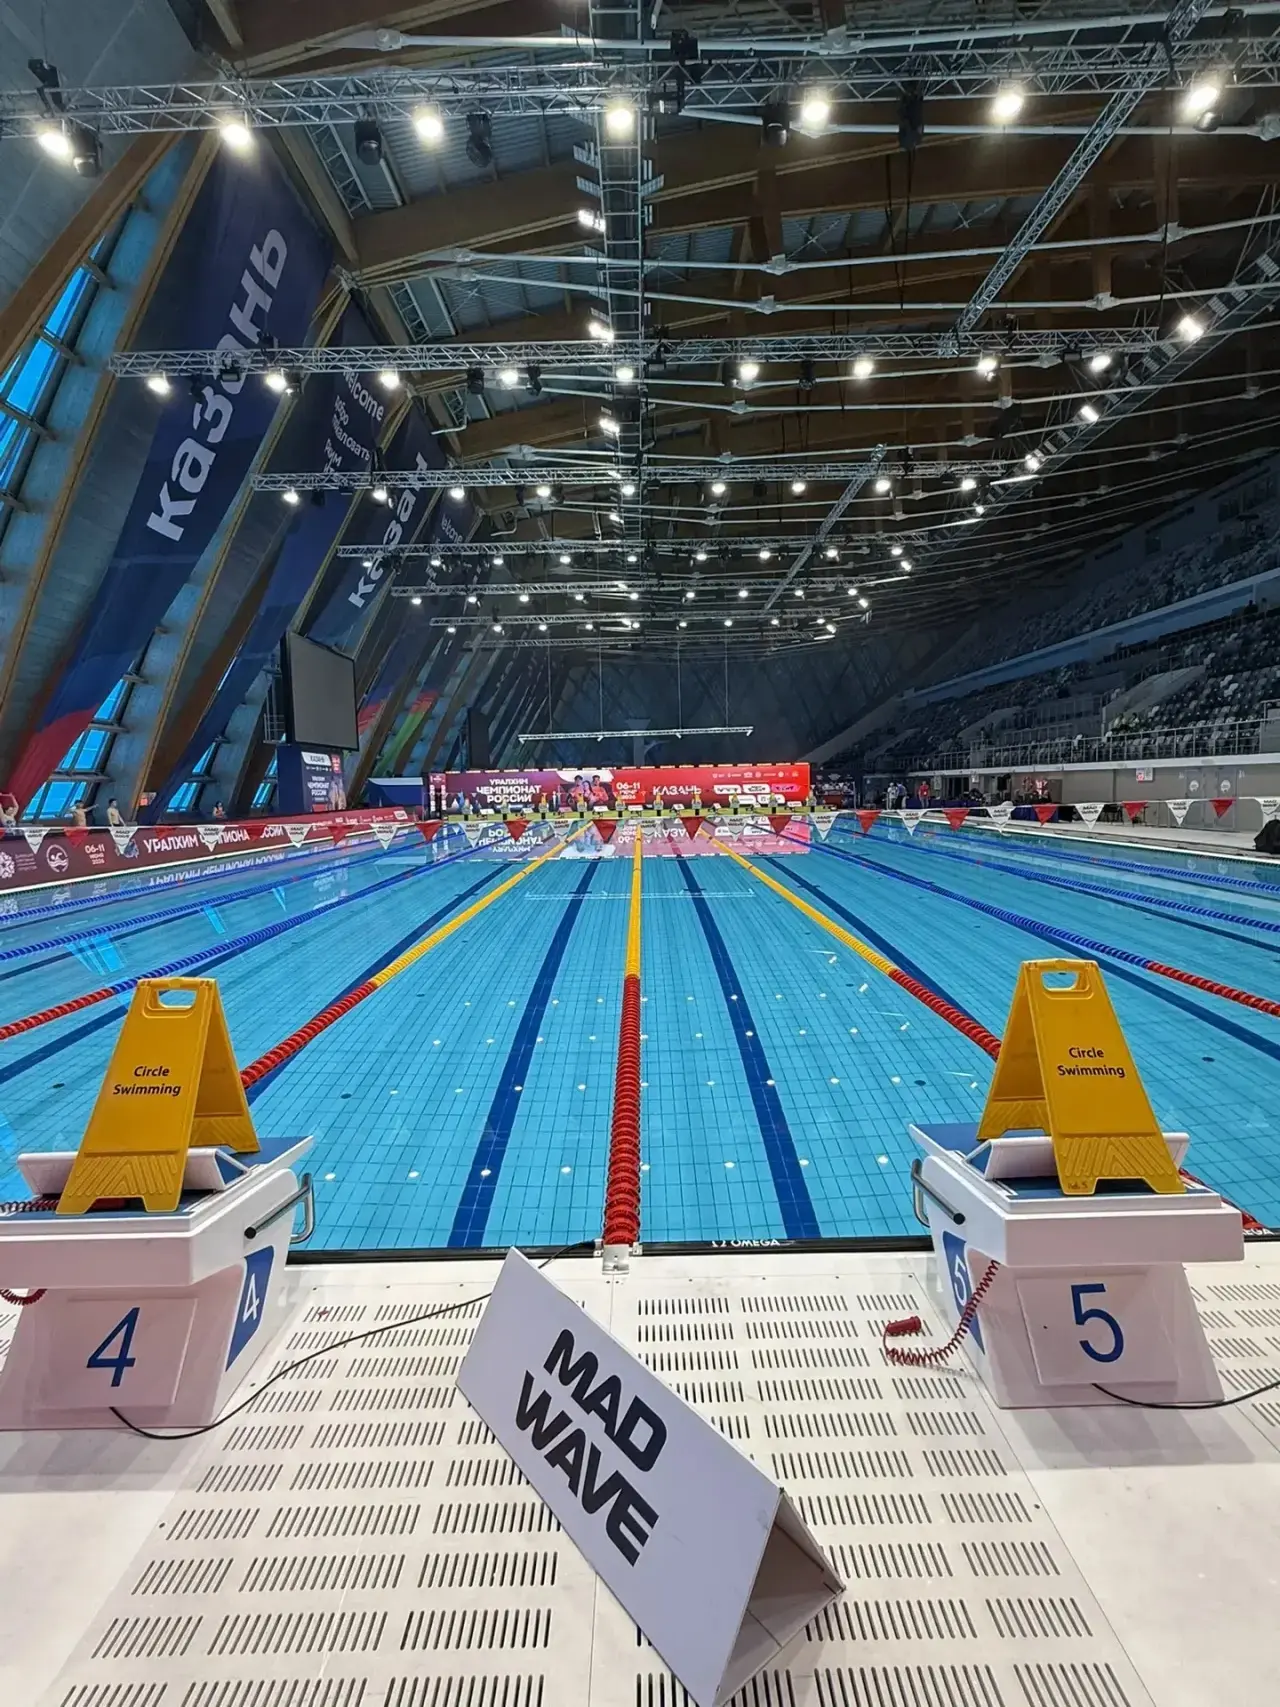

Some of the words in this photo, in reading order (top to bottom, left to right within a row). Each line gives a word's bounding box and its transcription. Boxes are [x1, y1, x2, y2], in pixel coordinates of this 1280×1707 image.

[476, 785, 542, 794] ЧЕМПИОНАТ
[616, 782, 640, 790] 06-11
[486, 794, 532, 803] РОССИИ
[144, 834, 198, 853] УРАЛХИМ
[200, 829, 250, 844] ЧПИОНА
[84, 844, 105, 854] 06-11
[1068, 1046, 1104, 1058] Circle
[134, 1066, 170, 1077] Circle
[1057, 1065, 1126, 1078] Swimming
[112, 1083, 182, 1097] Swimming
[730, 1238, 780, 1247] OMEGA
[954, 1254, 968, 1306] 5
[242, 1273, 260, 1322] 4
[1070, 1283, 1124, 1364] 5
[86, 1307, 140, 1388] 4
[543, 1329, 667, 1472] MAD
[516, 1370, 660, 1568] WAVE
